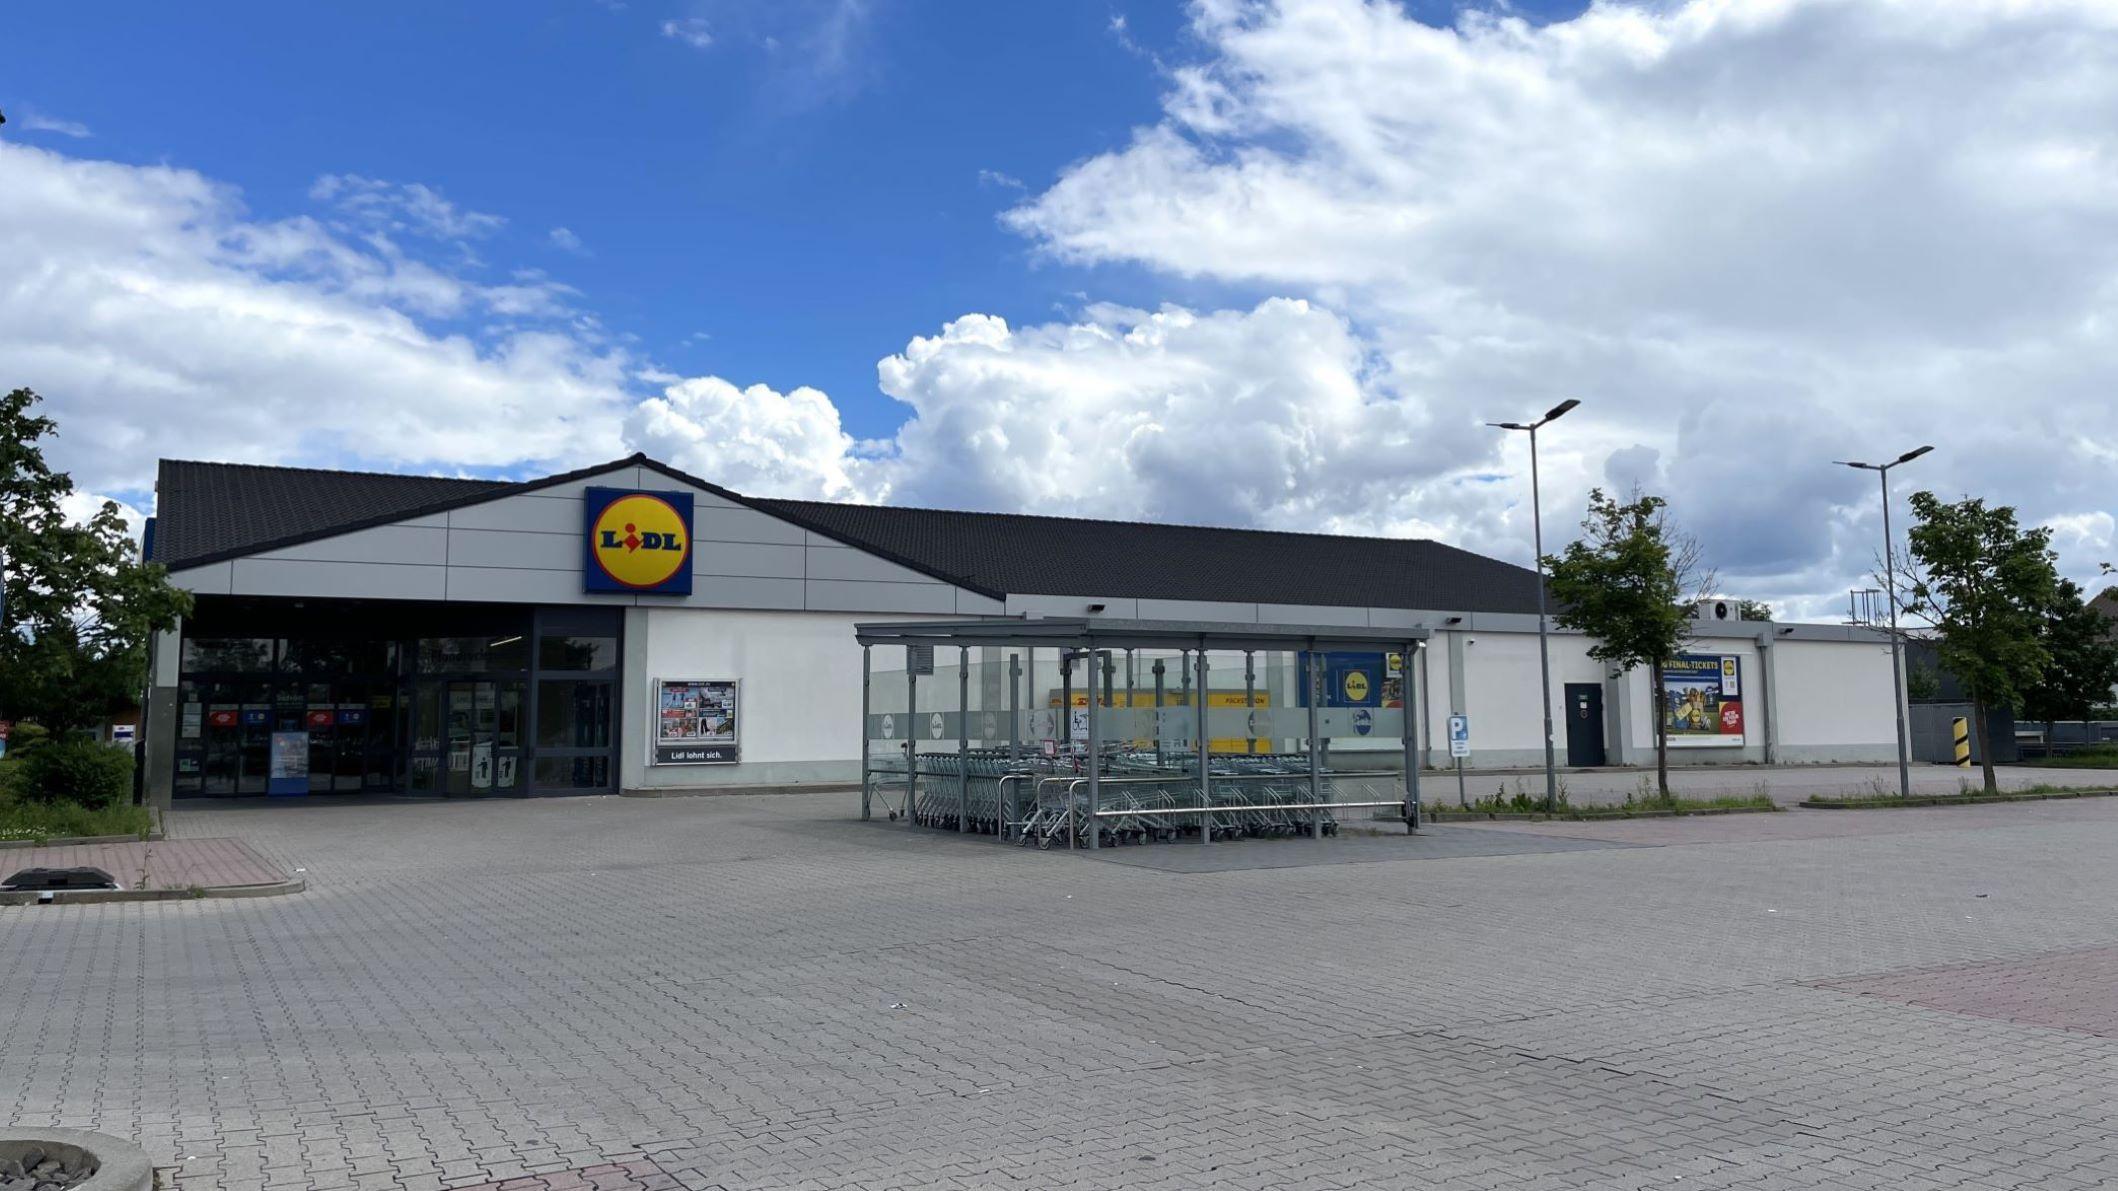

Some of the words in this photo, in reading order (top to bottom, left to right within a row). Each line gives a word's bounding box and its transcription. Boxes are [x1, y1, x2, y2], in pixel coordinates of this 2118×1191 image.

[1450, 717, 1463, 740] P
[671, 751, 685, 760] Lidl
[686, 751, 705, 759] lohnt
[706, 750, 723, 759] sich.
